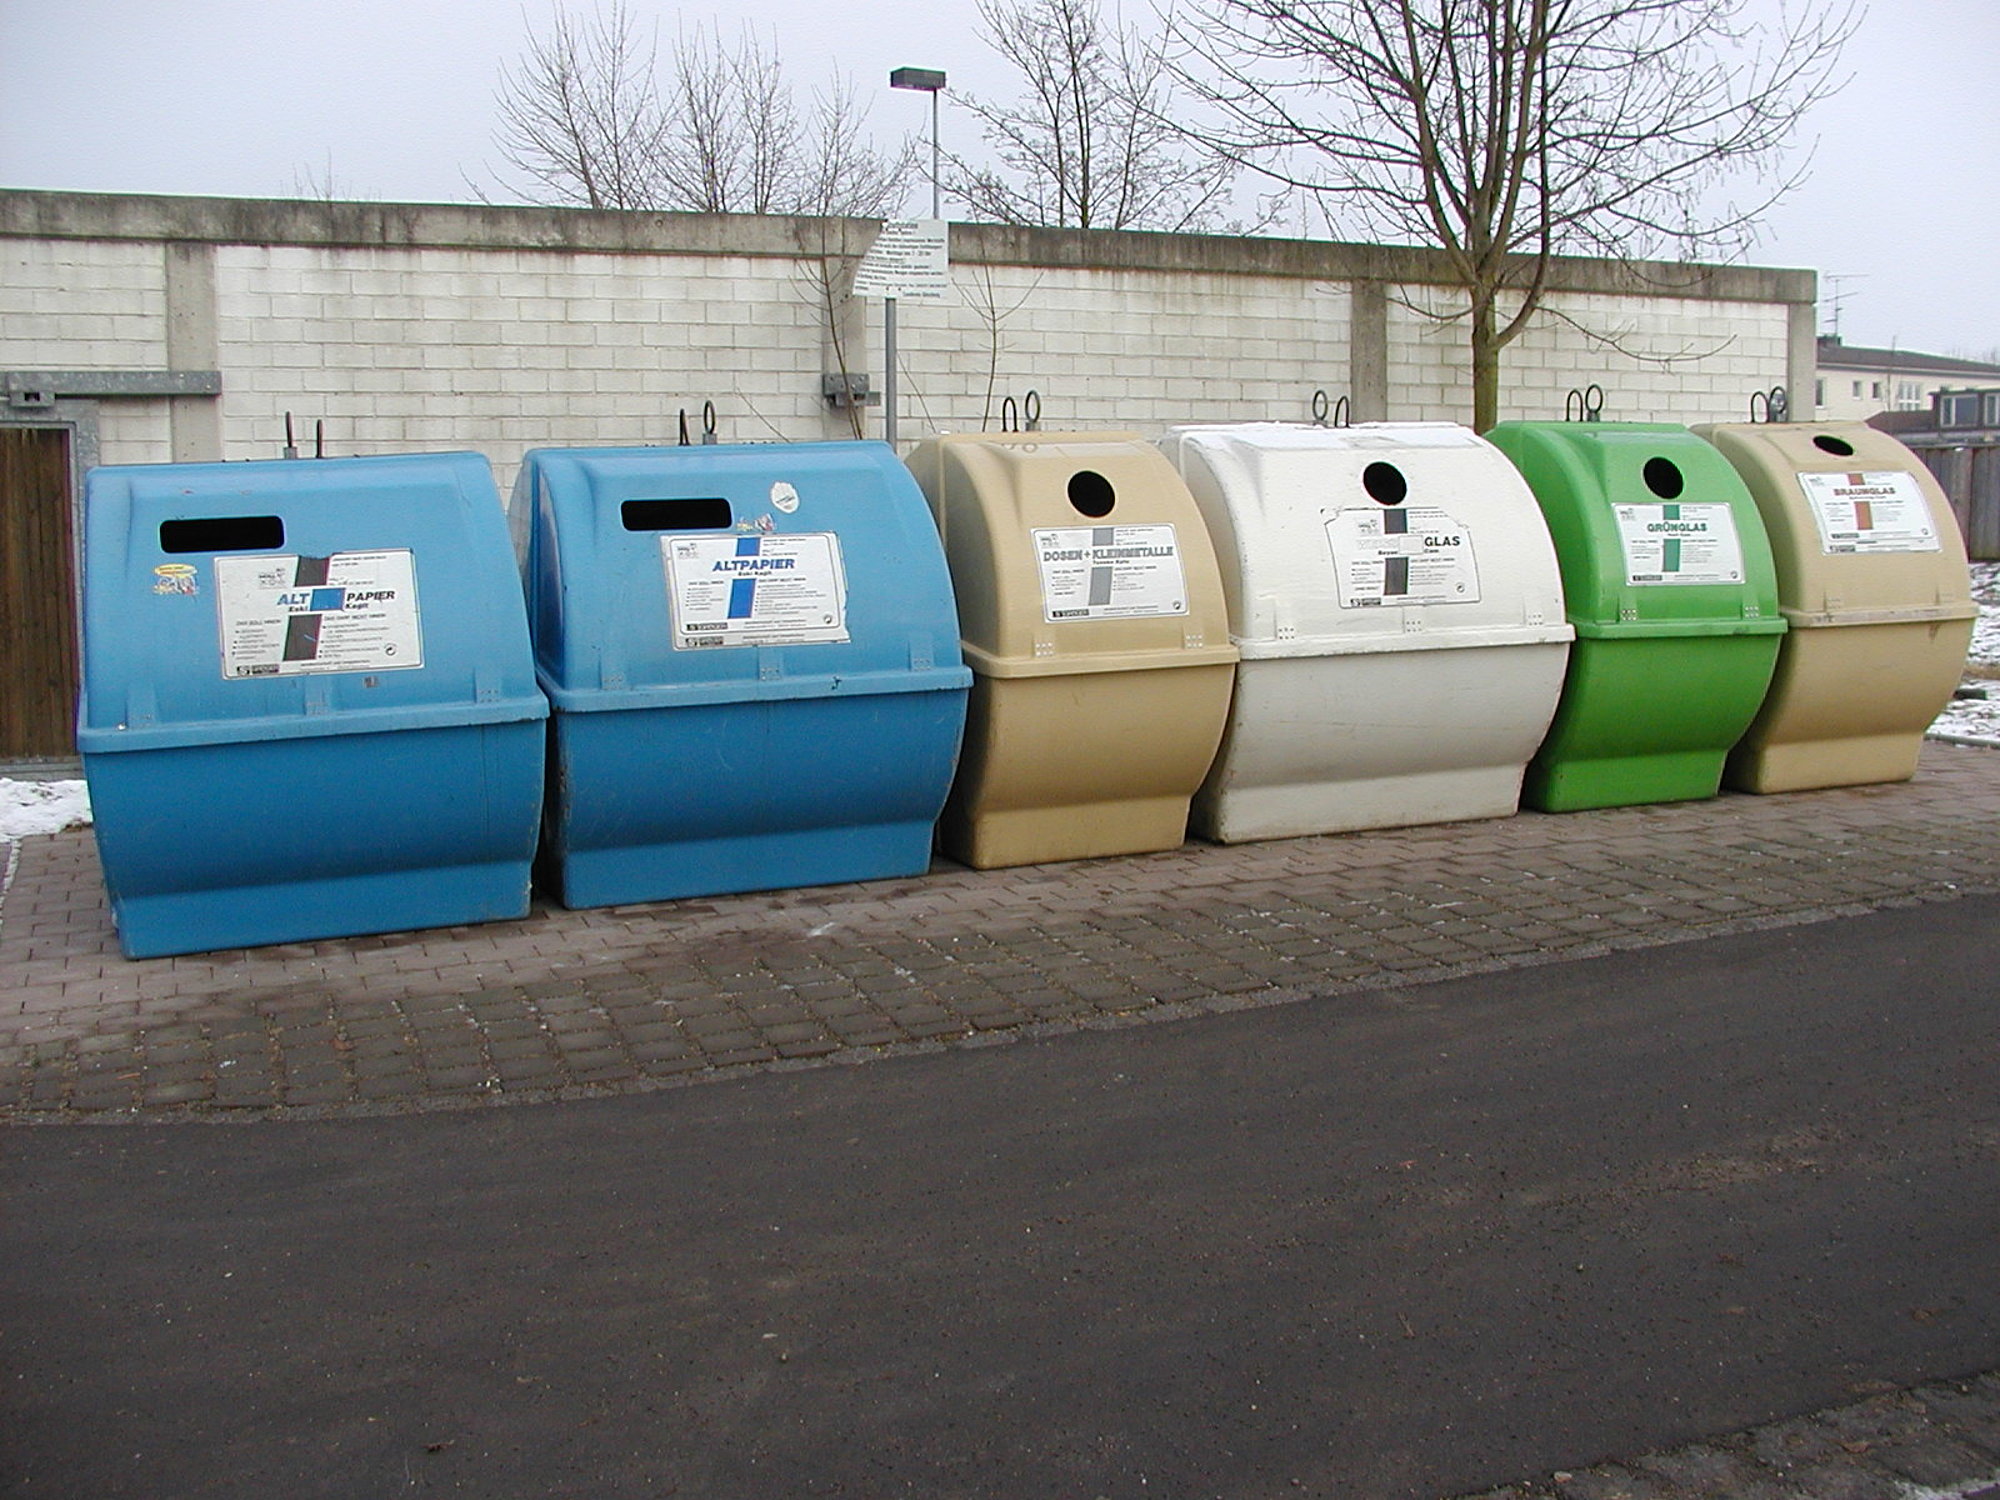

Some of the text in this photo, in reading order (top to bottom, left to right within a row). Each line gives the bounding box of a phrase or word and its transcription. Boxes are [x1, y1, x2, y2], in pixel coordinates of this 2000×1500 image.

[1834, 487, 1896, 496] BRAUNGLAS
[1647, 521, 1708, 532] GRÜNGLAS
[1424, 536, 1461, 547] GLAS
[1043, 549, 1083, 562] DOSEN
[1092, 546, 1174, 560] KLEINMETALLE
[712, 558, 796, 572] ALTPAPIER
[277, 590, 396, 606] ALT PAPIER
